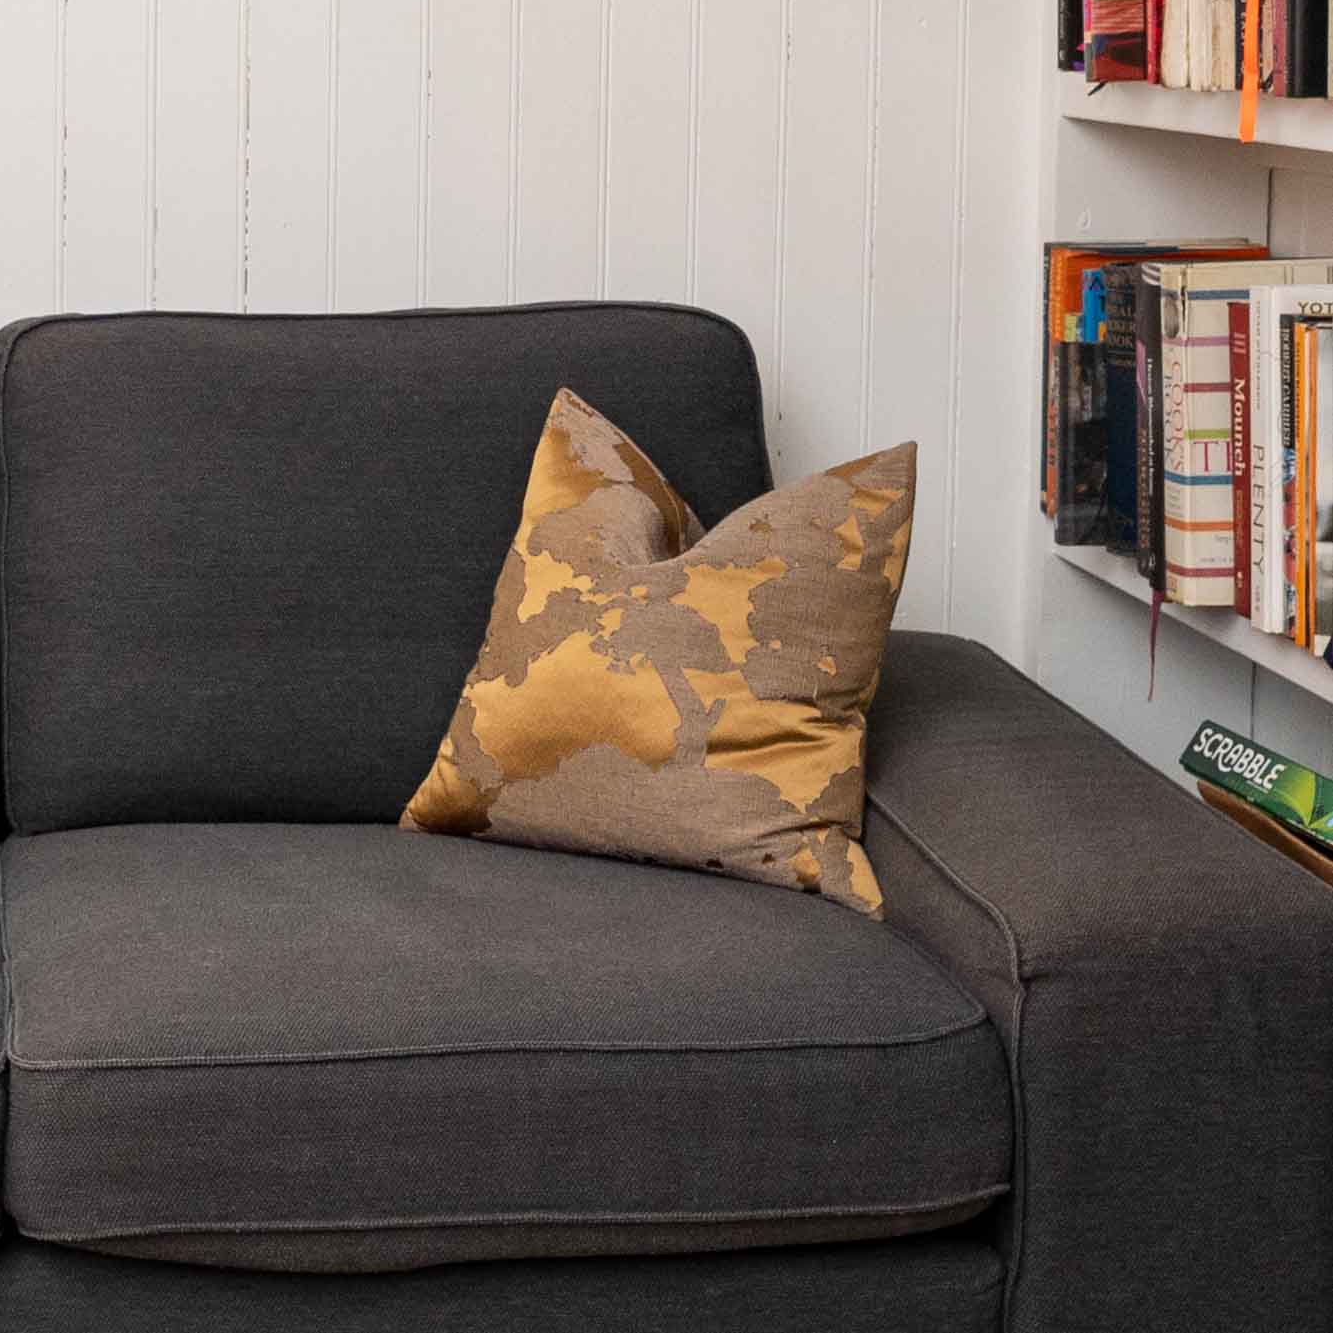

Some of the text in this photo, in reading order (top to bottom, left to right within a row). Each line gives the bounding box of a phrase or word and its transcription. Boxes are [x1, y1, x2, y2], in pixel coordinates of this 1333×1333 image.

[1234, 379, 1246, 476] Mounch
[1282, 327, 1292, 448] ROBERT CARRIER
[1253, 444, 1266, 576] PLENTY
[1193, 728, 1286, 790] SCRABBLE
